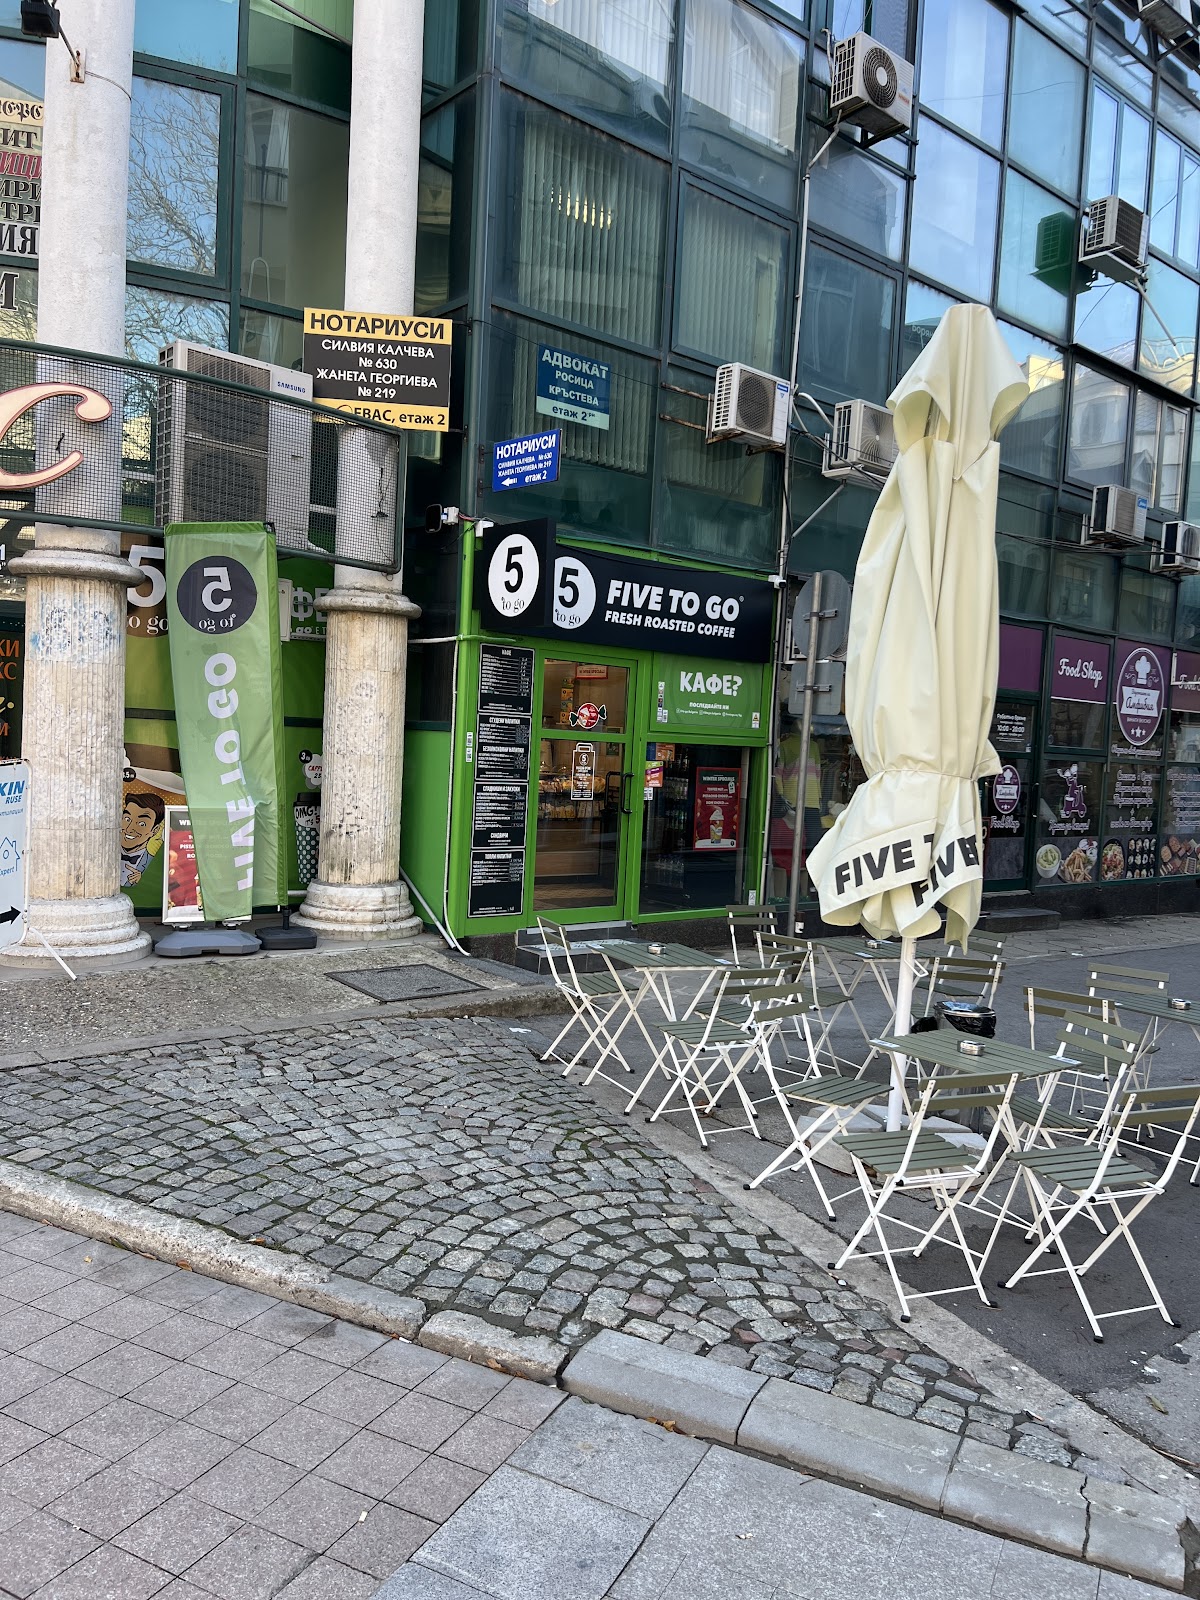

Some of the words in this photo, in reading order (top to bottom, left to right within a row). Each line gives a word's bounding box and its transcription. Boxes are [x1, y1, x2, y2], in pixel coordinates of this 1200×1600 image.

[310, 313, 444, 339] НОТАРИУСИ
[321, 339, 375, 354] СИЛВИЯ
[377, 344, 435, 358] КАЛЧЕВА
[359, 357, 373, 368] №
[375, 358, 398, 370] 630
[541, 349, 609, 379] АДВОКАТ
[277, 381, 306, 394] SAMSUNG
[316, 368, 367, 383] ЖАНЕТА
[370, 373, 438, 389] ГЕОРГИЕВА
[555, 370, 594, 390] РОСИЦА
[358, 386, 372, 397] №
[375, 387, 396, 399] 219
[549, 384, 599, 406] КРЪСТЕВА
[399, 413, 434, 424] етаж
[437, 414, 445, 425] 2
[552, 405, 579, 419] етаж
[496, 433, 557, 460] НОТАРИУСИ
[525, 473, 542, 483] етаж
[542, 470, 547, 480] 2
[127, 545, 166, 608] 5
[504, 546, 523, 593] 5
[558, 566, 580, 608] 5
[501, 597, 512, 611] to
[512, 598, 525, 613] go
[607, 579, 663, 611] FIVE
[668, 589, 700, 616] TO
[705, 595, 741, 621] GO
[127, 615, 140, 628] o
[555, 608, 567, 623] to
[568, 612, 581, 626] go
[604, 610, 642, 627] FRESH
[645, 616, 695, 634] ROASTED
[697, 622, 736, 639] COFFEE
[1058, 658, 1080, 677] Food
[1081, 661, 1103, 688] Shop
[680, 671, 743, 697] КАФЕ?
[6, 795, 22, 804] RUSE
[835, 839, 915, 896] FIVE
